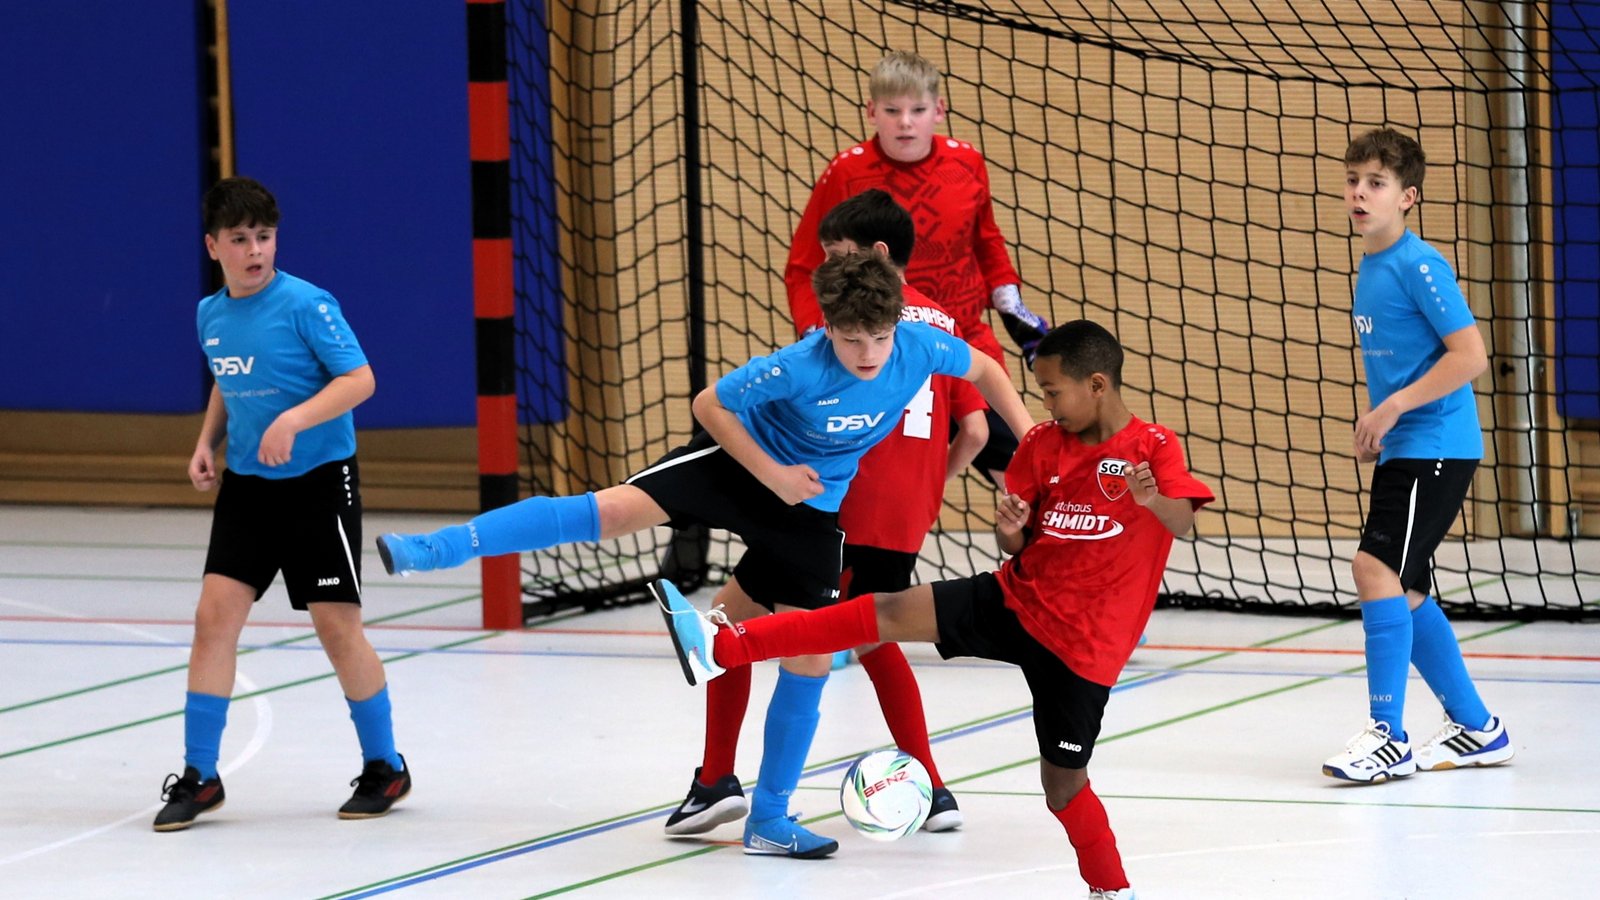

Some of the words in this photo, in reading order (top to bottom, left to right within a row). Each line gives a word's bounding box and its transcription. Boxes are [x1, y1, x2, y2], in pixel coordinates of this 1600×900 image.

[212, 356, 255, 376] DSV
[817, 398, 840, 406] JAKO
[826, 411, 886, 433] DSV
[317, 577, 340, 587] JAKO
[1058, 740, 1082, 752] JAKO
[864, 771, 909, 798] BENZ
